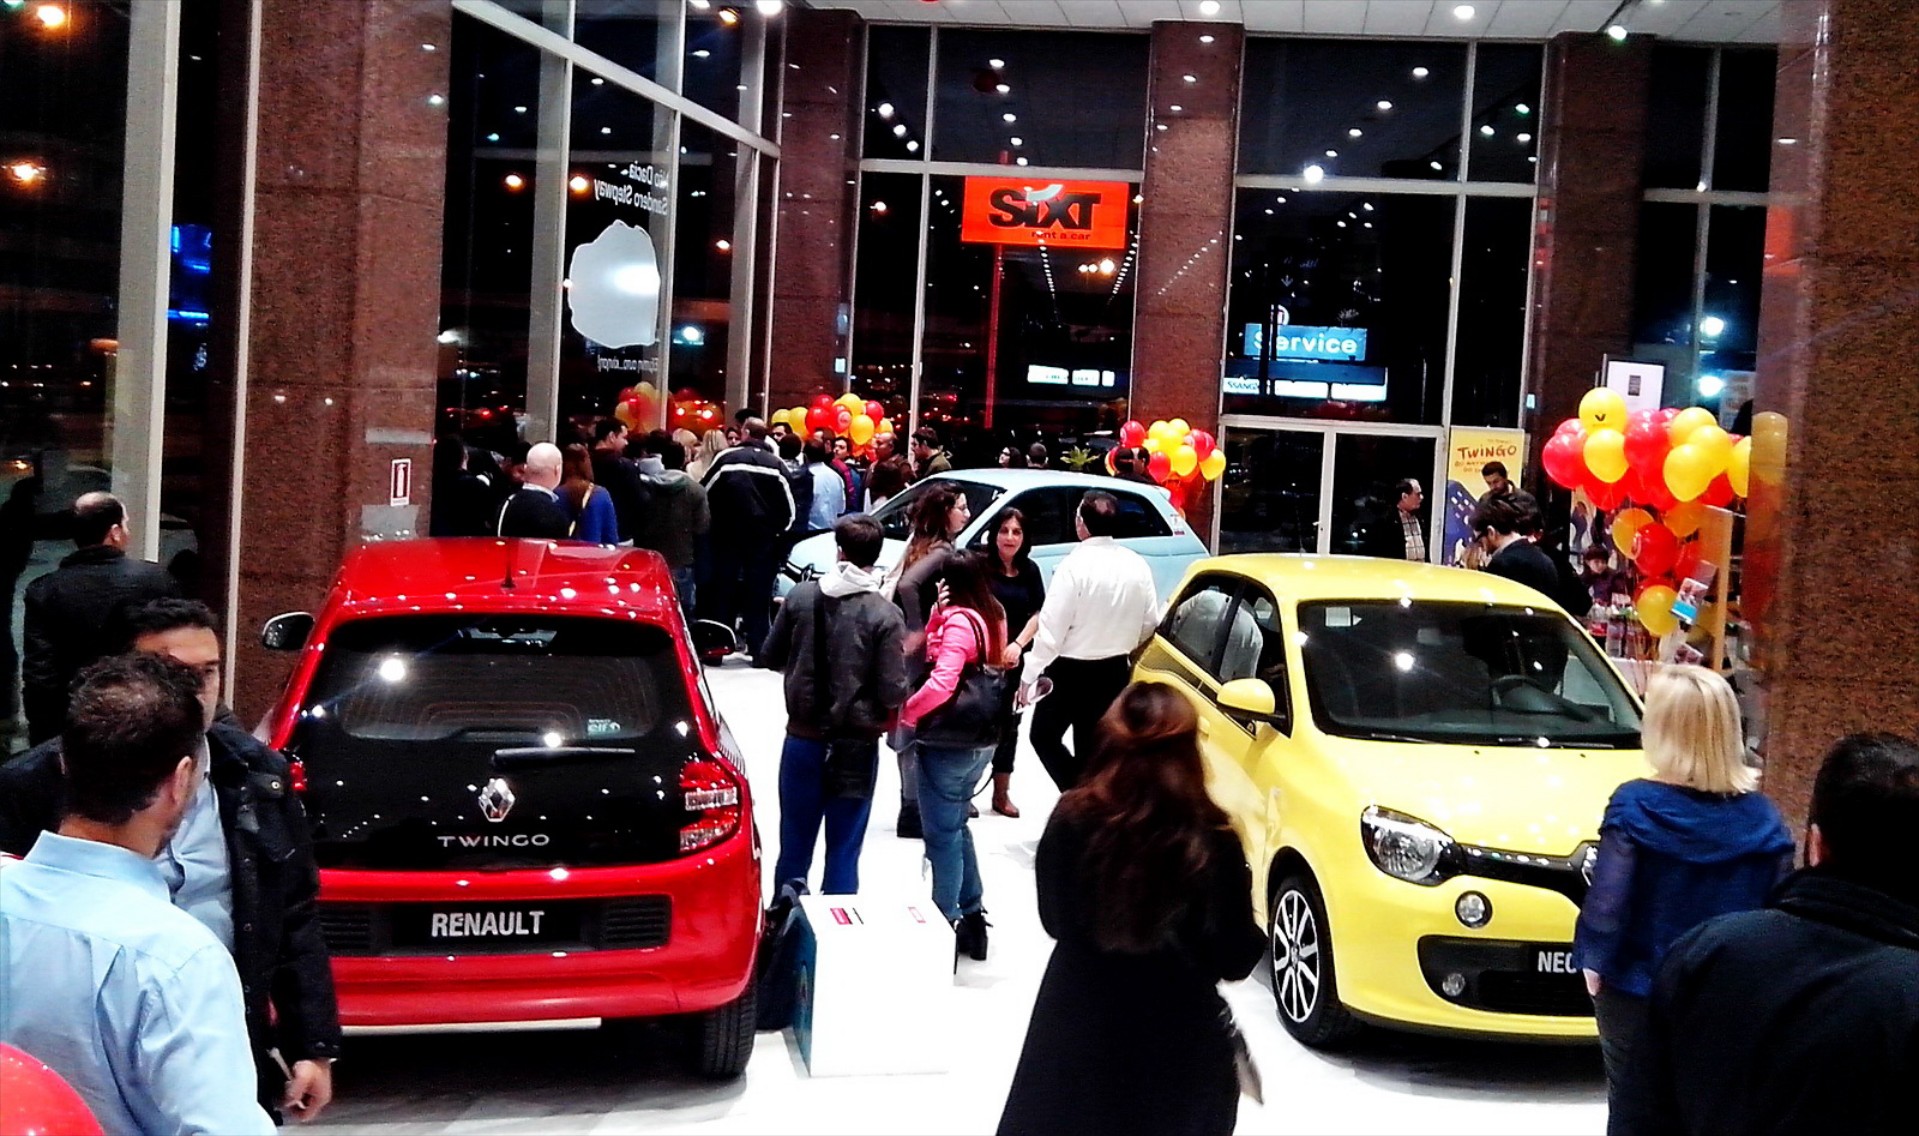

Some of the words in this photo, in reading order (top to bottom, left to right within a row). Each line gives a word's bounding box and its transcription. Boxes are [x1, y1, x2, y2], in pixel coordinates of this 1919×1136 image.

[1059, 231, 1067, 240] a
[1069, 232, 1091, 241] car
[1253, 331, 1358, 354] Service
[437, 833, 550, 848] TWINGO
[431, 910, 545, 937] RENAULT
